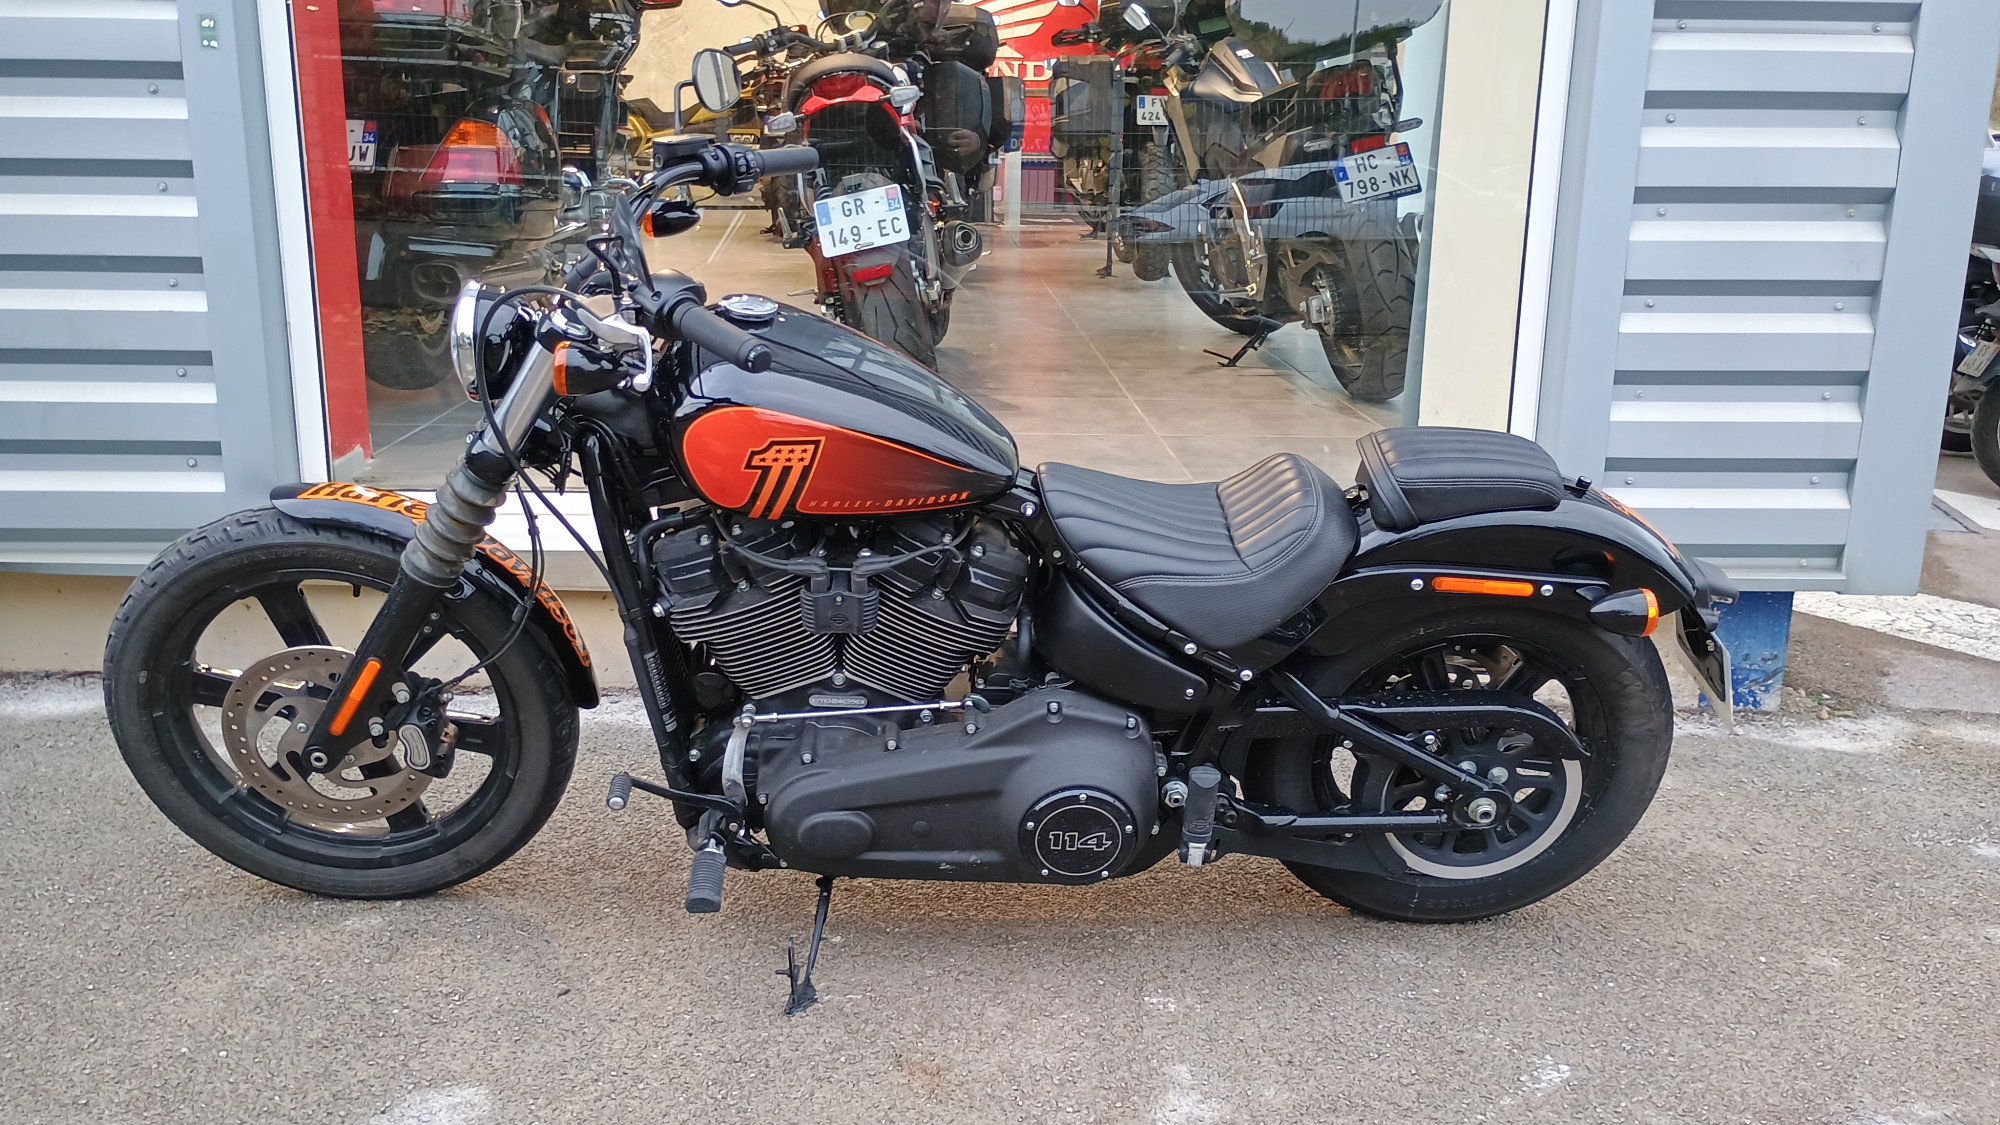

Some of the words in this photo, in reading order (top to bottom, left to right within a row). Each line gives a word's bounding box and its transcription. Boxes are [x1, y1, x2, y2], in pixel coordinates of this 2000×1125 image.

[363, 132, 375, 142] 34
[888, 199, 901, 211] 34
[828, 216, 903, 248] 149-EC
[808, 490, 972, 508] HARLEY-DAVIDSON
[1049, 831, 1113, 851] 114
